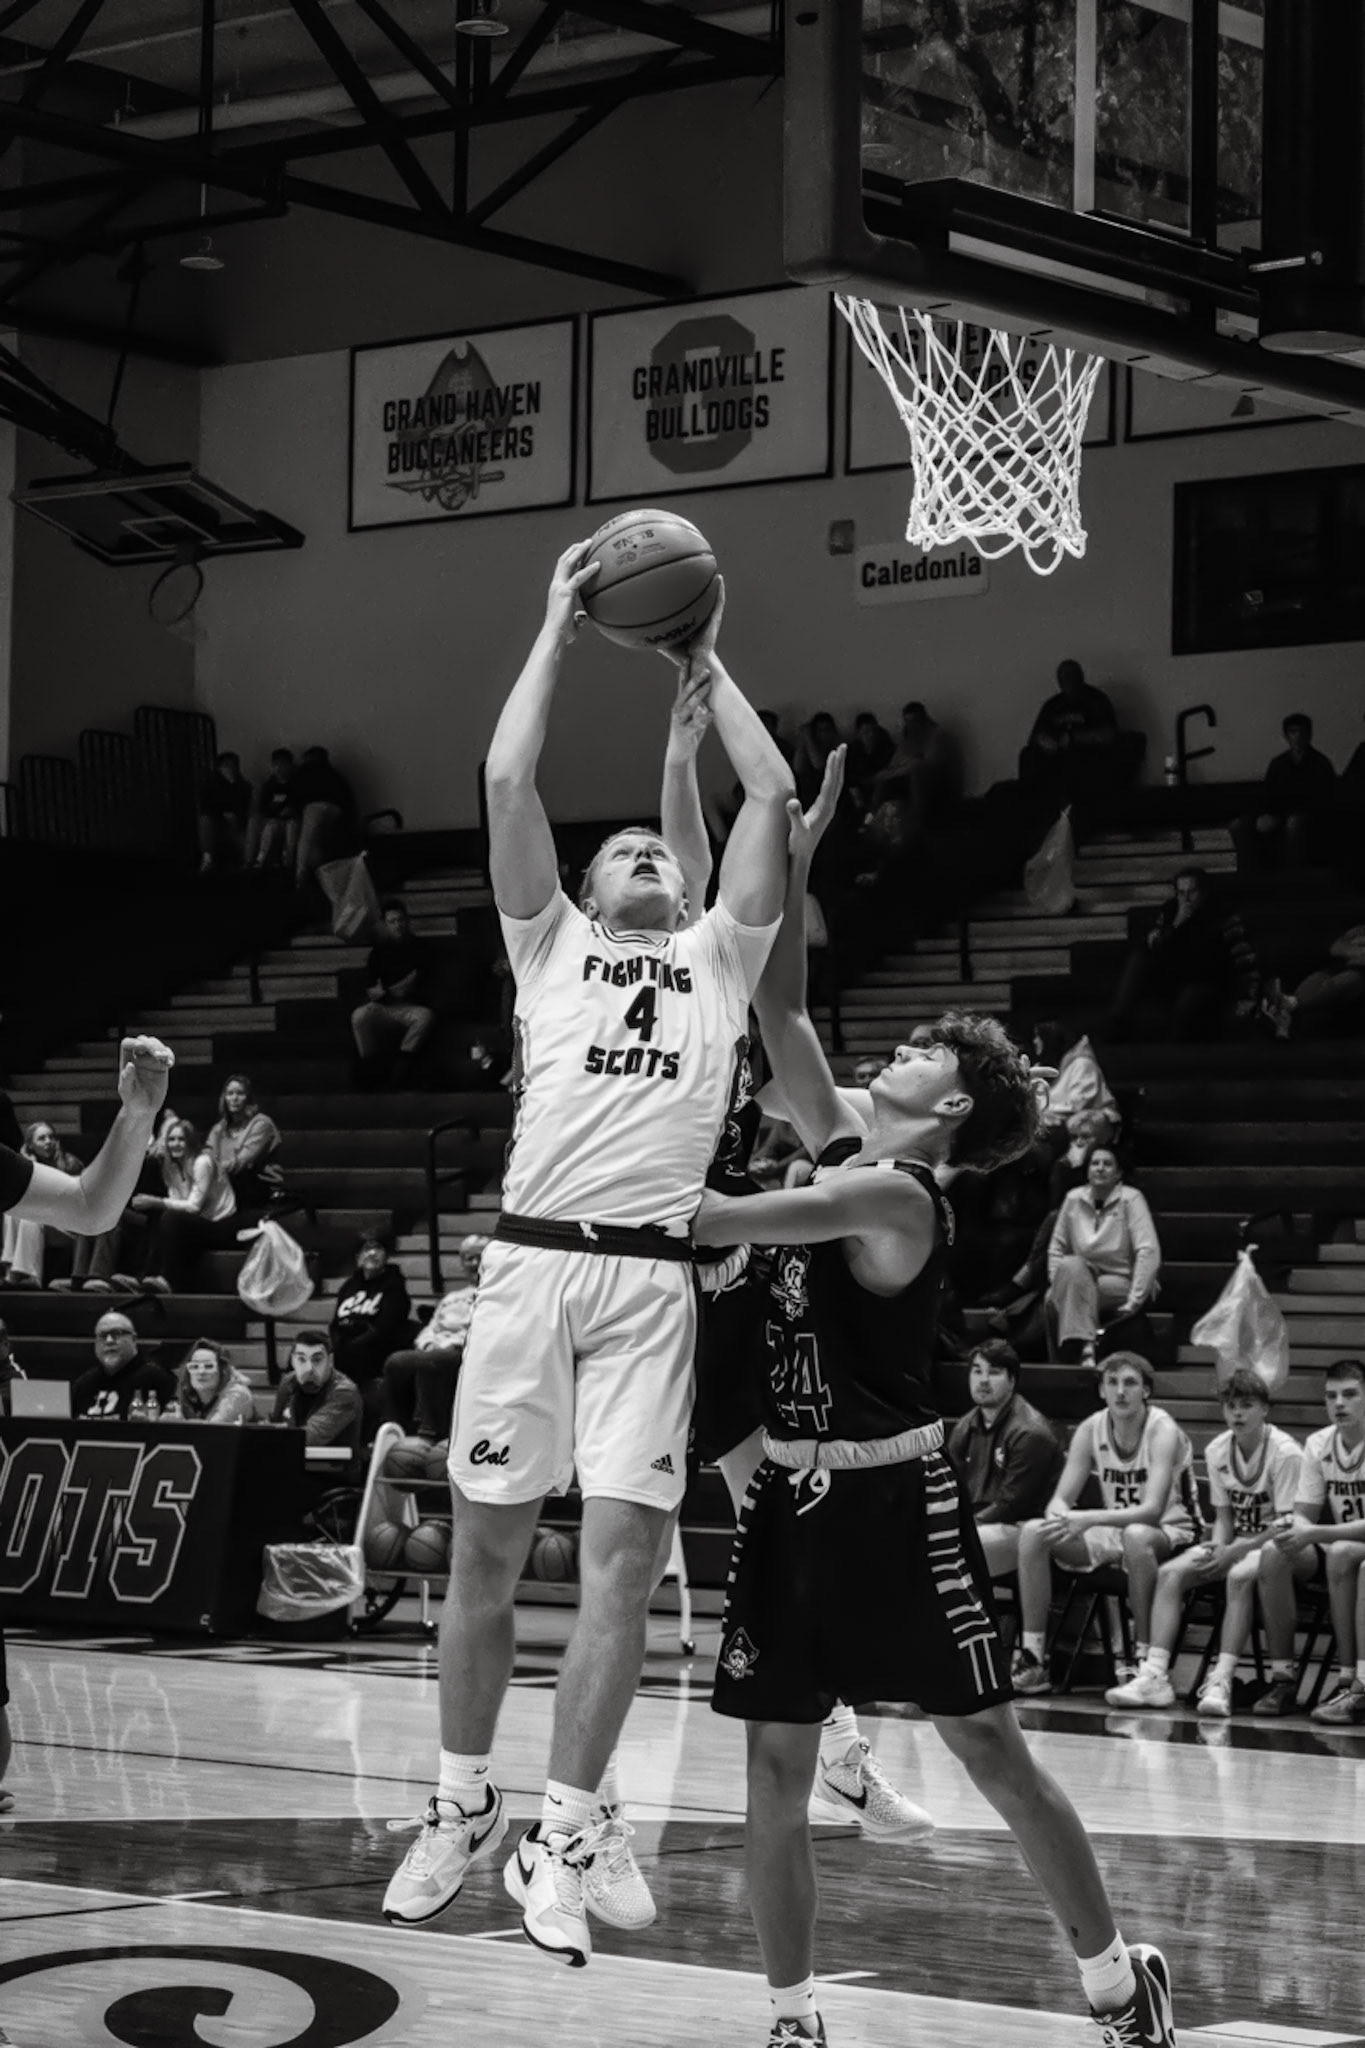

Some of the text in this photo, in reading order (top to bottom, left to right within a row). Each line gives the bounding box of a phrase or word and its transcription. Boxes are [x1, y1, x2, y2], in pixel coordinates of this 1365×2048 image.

[633, 349, 784, 400] GRANDVILLE
[384, 382, 540, 432] GRAND HAVEN
[647, 395, 769, 442] BULLDOGS
[388, 426, 533, 474] BUCCANEERS
[862, 552, 981, 587] Caledonia
[624, 986, 658, 1041] 4
[585, 1045, 680, 1079] SCOTS
[470, 1439, 510, 1466] Cal
[0, 1436, 204, 1604] OTS
[1342, 1497, 1365, 1523] 21
